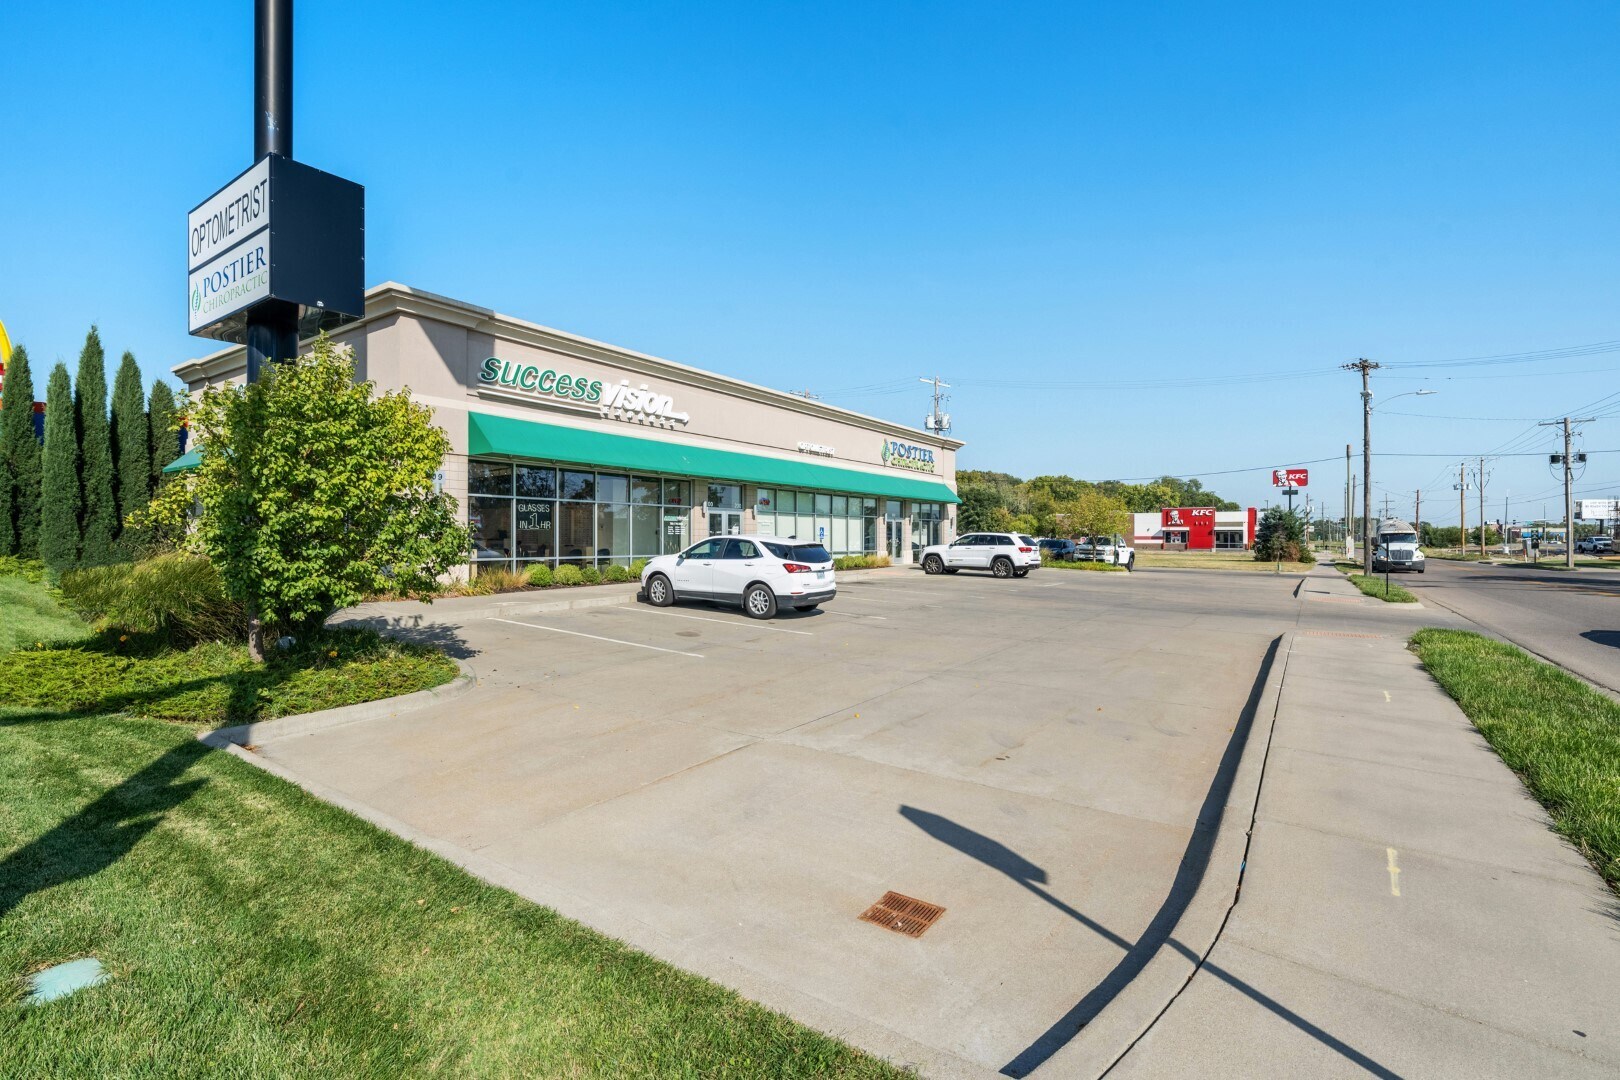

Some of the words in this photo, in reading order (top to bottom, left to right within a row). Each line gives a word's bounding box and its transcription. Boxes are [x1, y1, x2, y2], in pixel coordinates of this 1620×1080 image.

[191, 178, 268, 257] OPTOMETRIST
[203, 246, 267, 298] POSTIER
[203, 270, 268, 314] CHIROPRACTIC
[890, 441, 934, 463] POSTIER
[518, 503, 550, 512] GLASSES
[519, 520, 528, 529] IN
[529, 512, 540, 530] 1
[540, 520, 552, 529] HR
